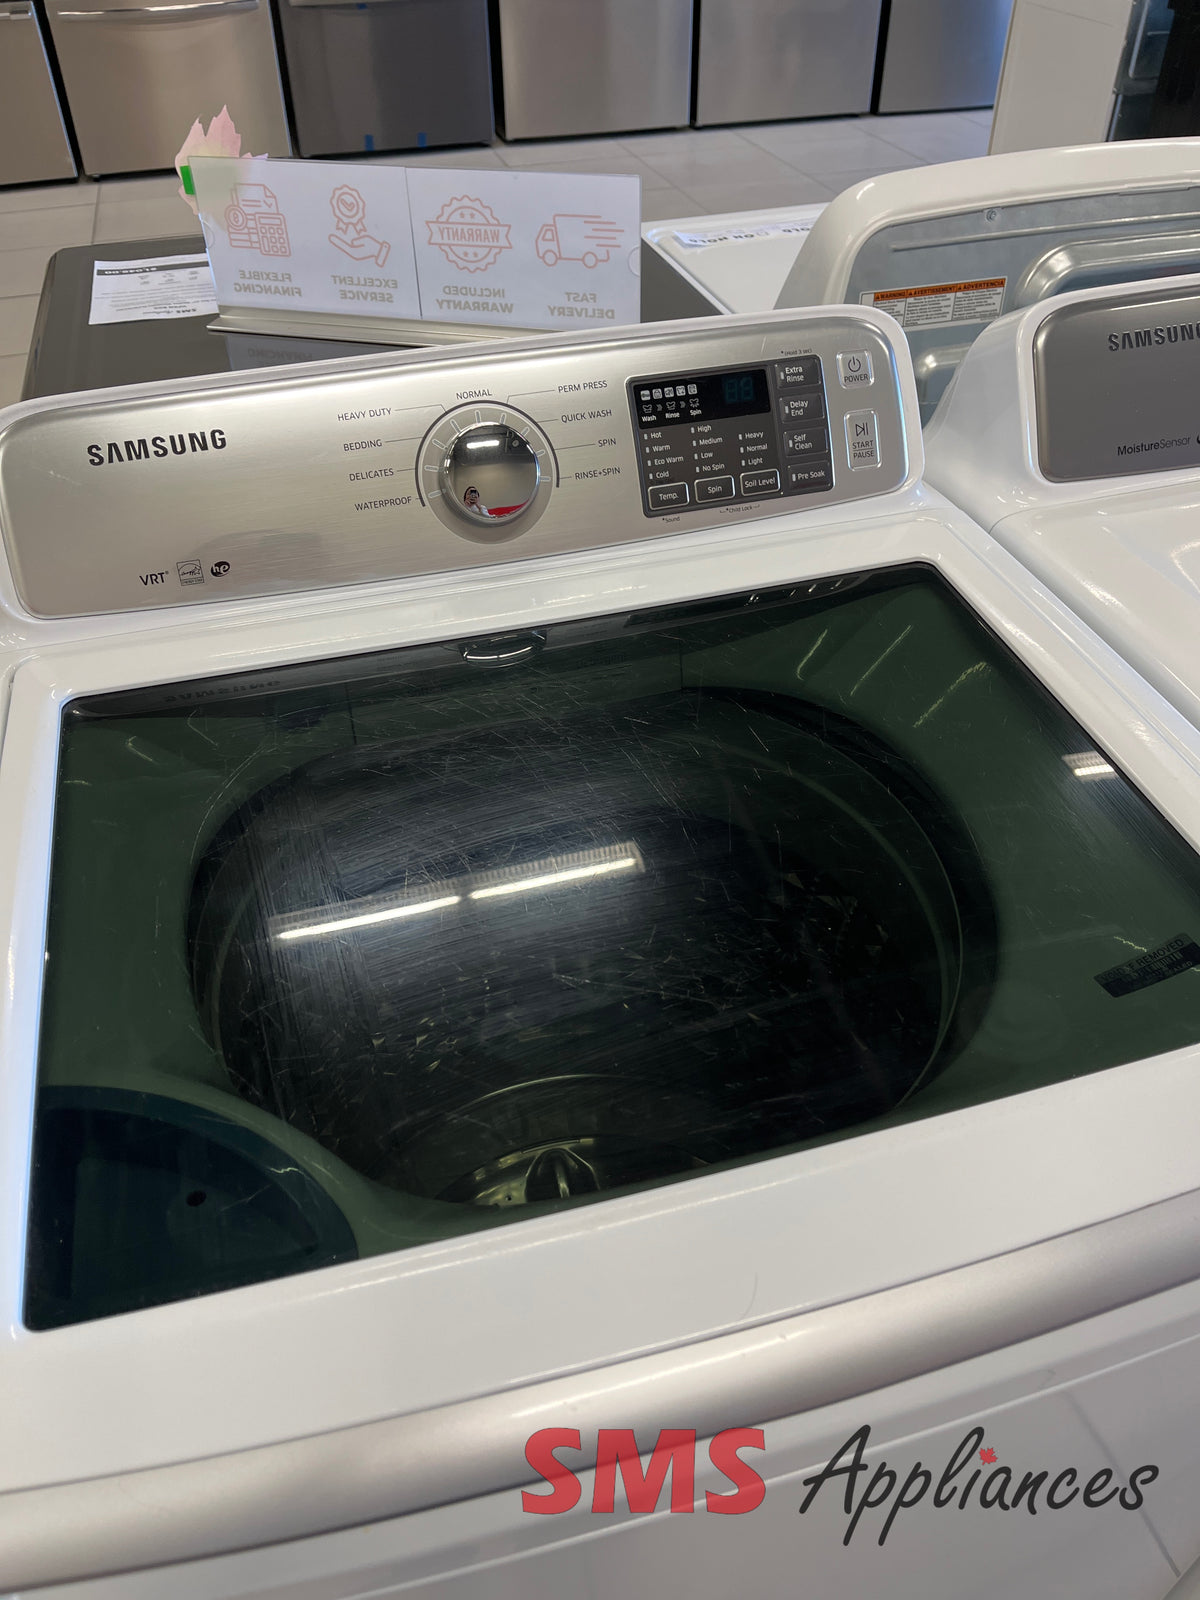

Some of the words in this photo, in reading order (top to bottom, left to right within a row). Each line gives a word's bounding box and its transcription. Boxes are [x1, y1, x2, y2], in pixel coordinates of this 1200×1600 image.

[785, 366, 803, 375] Extra
[786, 374, 804, 382] Rinse
[844, 373, 869, 383] POWER
[558, 383, 581, 393] PERM
[583, 380, 608, 390] PRESS
[456, 388, 493, 400] NORMAL
[790, 400, 809, 409] Delay
[337, 410, 366, 422] HEAVY
[369, 407, 392, 418] DUTY
[561, 412, 586, 424] QUICK
[587, 409, 612, 420] WASH
[665, 411, 680, 419] Rinse
[689, 408, 702, 417] Spin
[791, 408, 804, 417] End
[641, 414, 657, 423] Wash
[697, 425, 712, 433] High
[650, 431, 662, 439] Hot
[745, 431, 764, 440] Heavy
[794, 433, 806, 442] Self
[597, 438, 617, 448] SPIN
[699, 436, 723, 445] Medium
[852, 440, 874, 449] START
[87, 428, 227, 467] SAMSUNG
[343, 439, 383, 452] BEDDING
[652, 444, 671, 452] Warm
[746, 443, 768, 452] Normal
[795, 442, 813, 450] Clean
[1117, 436, 1191, 456] MoistureSensor
[701, 451, 713, 459] Low
[853, 450, 875, 459] PAUSE
[654, 458, 666, 466] Eco
[666, 455, 684, 464] Warm
[748, 456, 763, 466] Light
[712, 463, 725, 472] Spin
[349, 468, 394, 482] DELICATES
[574, 466, 621, 480] RINSE+SPIN
[655, 471, 670, 479] Cold
[797, 472, 809, 480] Pre
[810, 470, 825, 479] Soak
[744, 480, 757, 488] Soil
[758, 476, 776, 486] Level
[707, 484, 723, 494] Spin
[659, 491, 679, 501] Temp.
[354, 496, 412, 511] WATERPROOF
[1136, 939, 1184, 967] REMOVED
